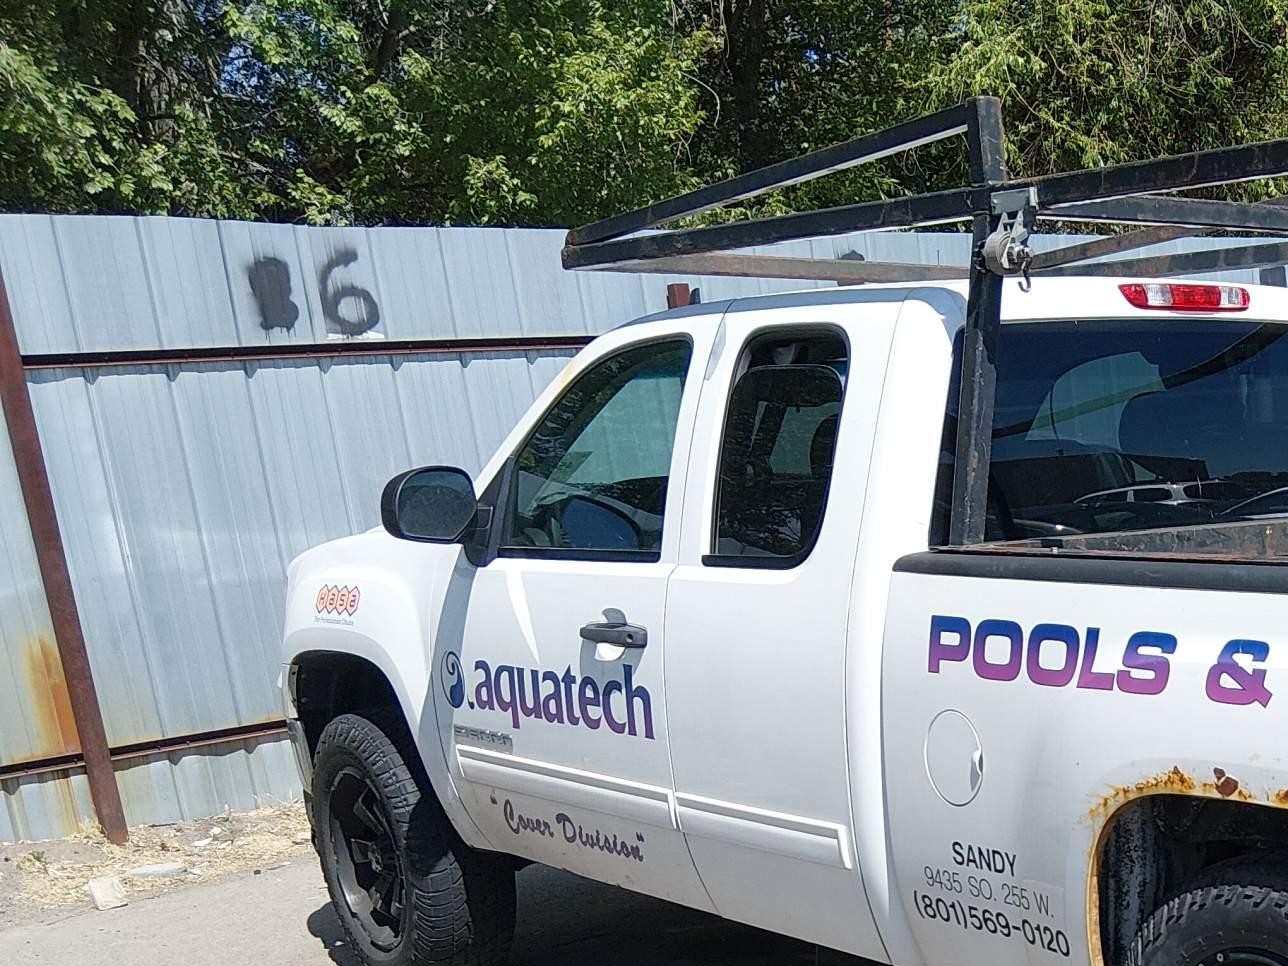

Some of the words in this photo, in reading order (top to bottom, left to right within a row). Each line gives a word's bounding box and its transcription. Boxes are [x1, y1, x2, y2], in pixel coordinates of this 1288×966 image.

[928, 615, 1177, 695] POOLS
[1205, 639, 1273, 708] &
[474, 660, 655, 740] aquatech
[924, 865, 962, 894] 9435
[968, 876, 997, 901] SO.
[1002, 883, 1030, 910] 255
[1033, 891, 1054, 918] W.
[952, 841, 1016, 877] SANDY
[914, 890, 1070, 957] (801)569-0120
